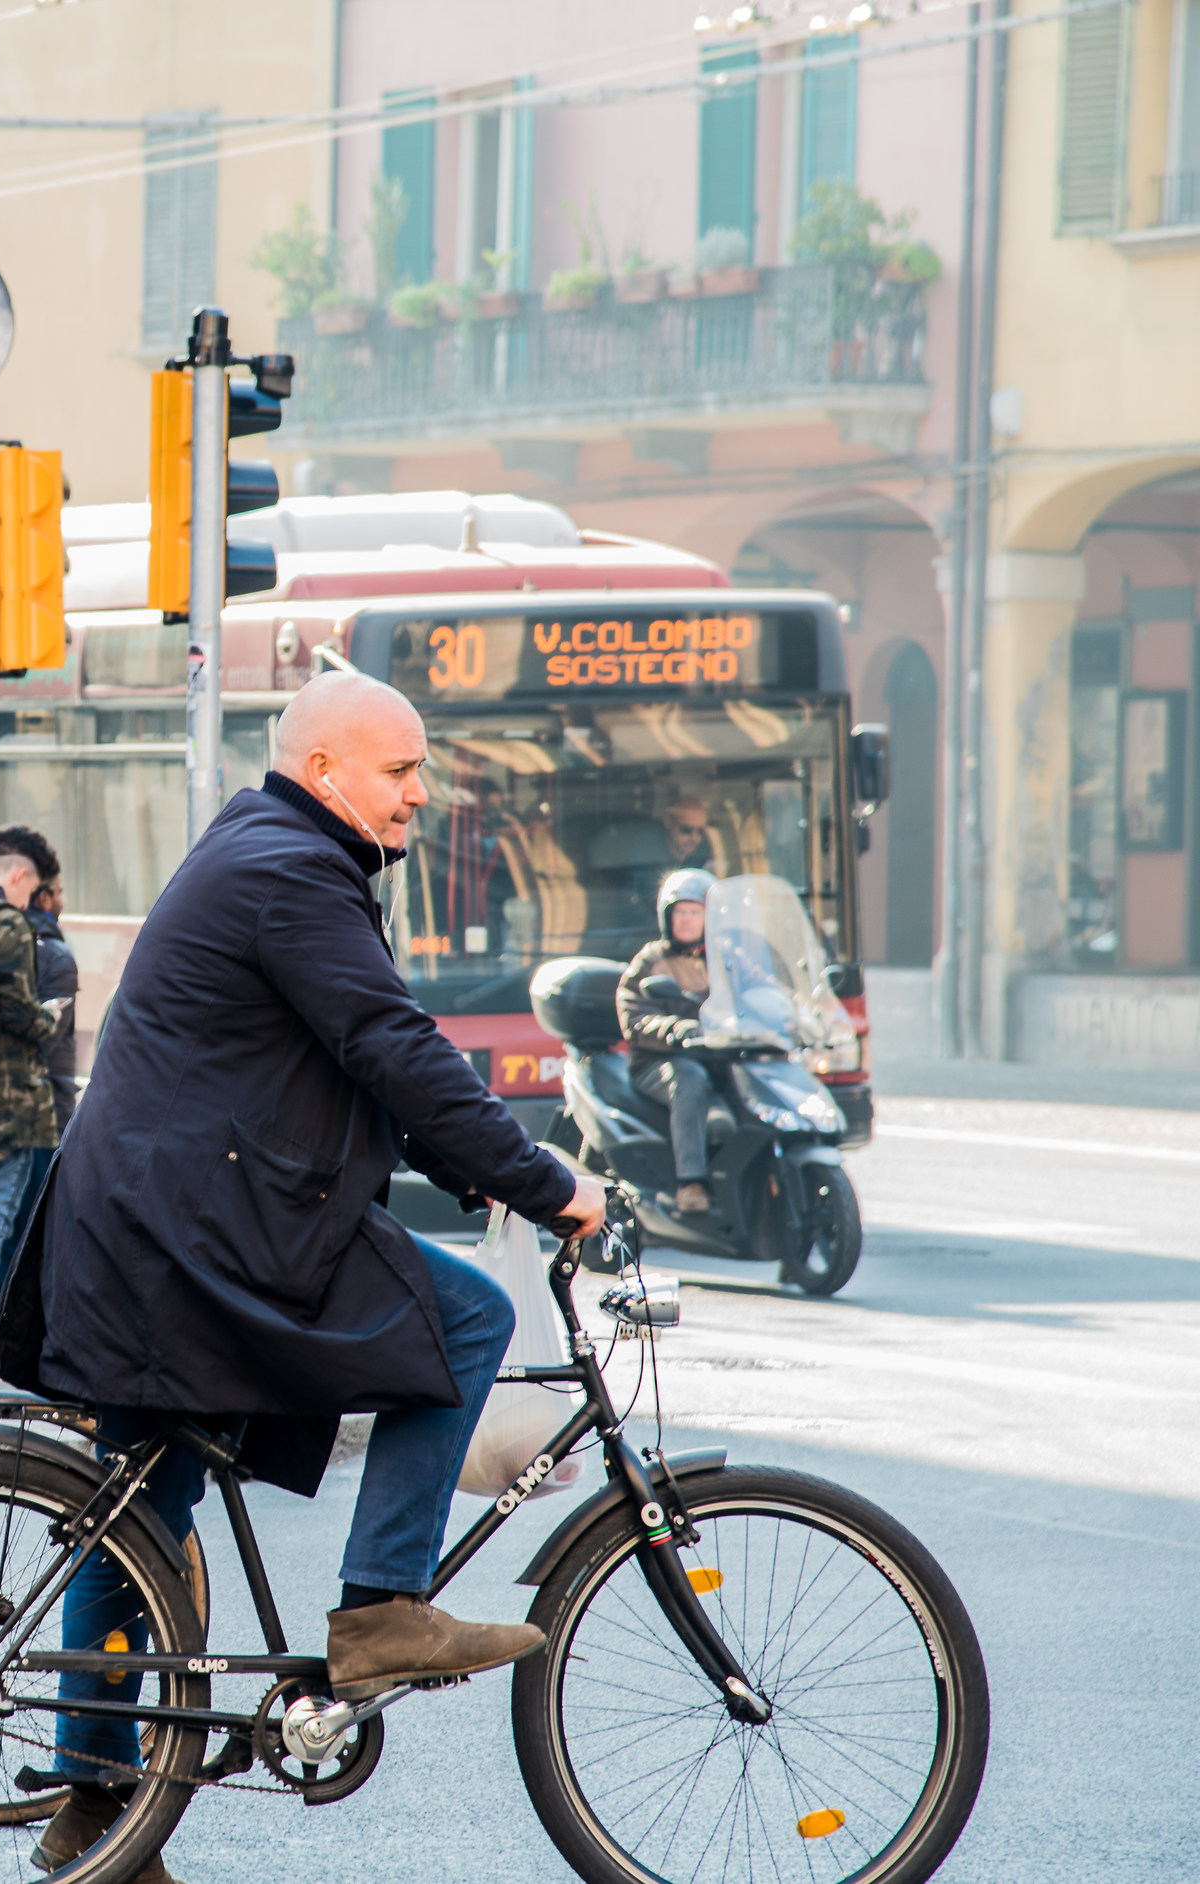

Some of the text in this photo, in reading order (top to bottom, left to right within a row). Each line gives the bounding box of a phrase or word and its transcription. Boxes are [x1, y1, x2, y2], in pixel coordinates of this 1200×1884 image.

[533, 617, 753, 654] V.COLOMBO
[429, 625, 486, 688] 30
[546, 650, 739, 686] SOSTEGNO
[496, 1453, 554, 1515] OLMO
[187, 1658, 229, 1673] OLMO
